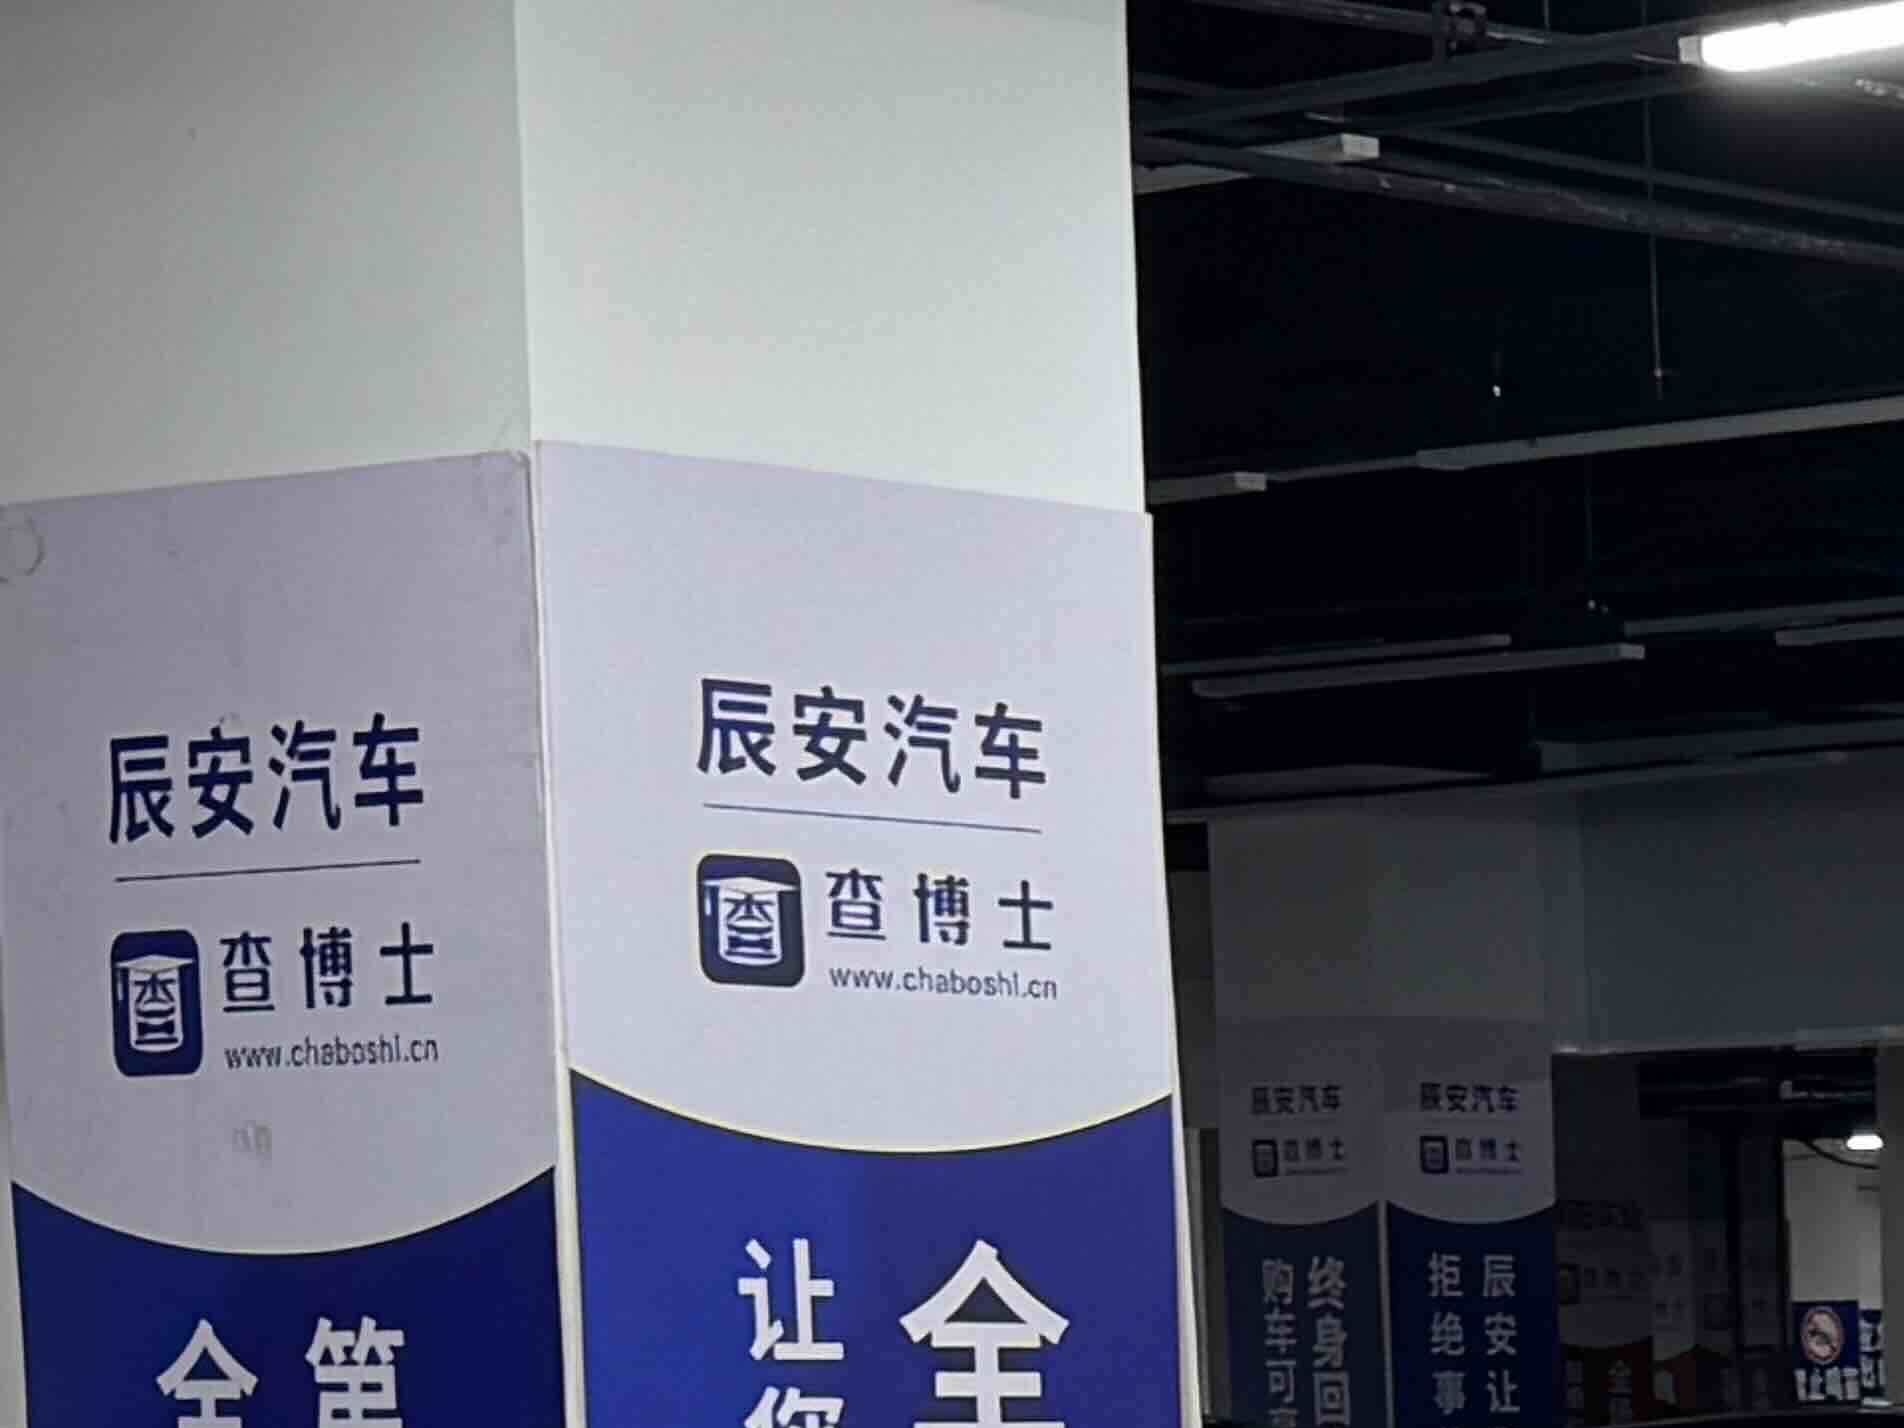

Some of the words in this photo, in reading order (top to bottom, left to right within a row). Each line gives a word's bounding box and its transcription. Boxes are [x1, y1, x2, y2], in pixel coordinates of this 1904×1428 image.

[107, 712, 425, 845] 辰安汽车
[695, 677, 1048, 799] 辰安汽车
[824, 867, 1055, 952] 查博士
[218, 921, 436, 1013] 查博士
[828, 963, 1059, 1002] www.chaboshi.cn
[223, 1033, 439, 1070] www.chaboshi.cn
